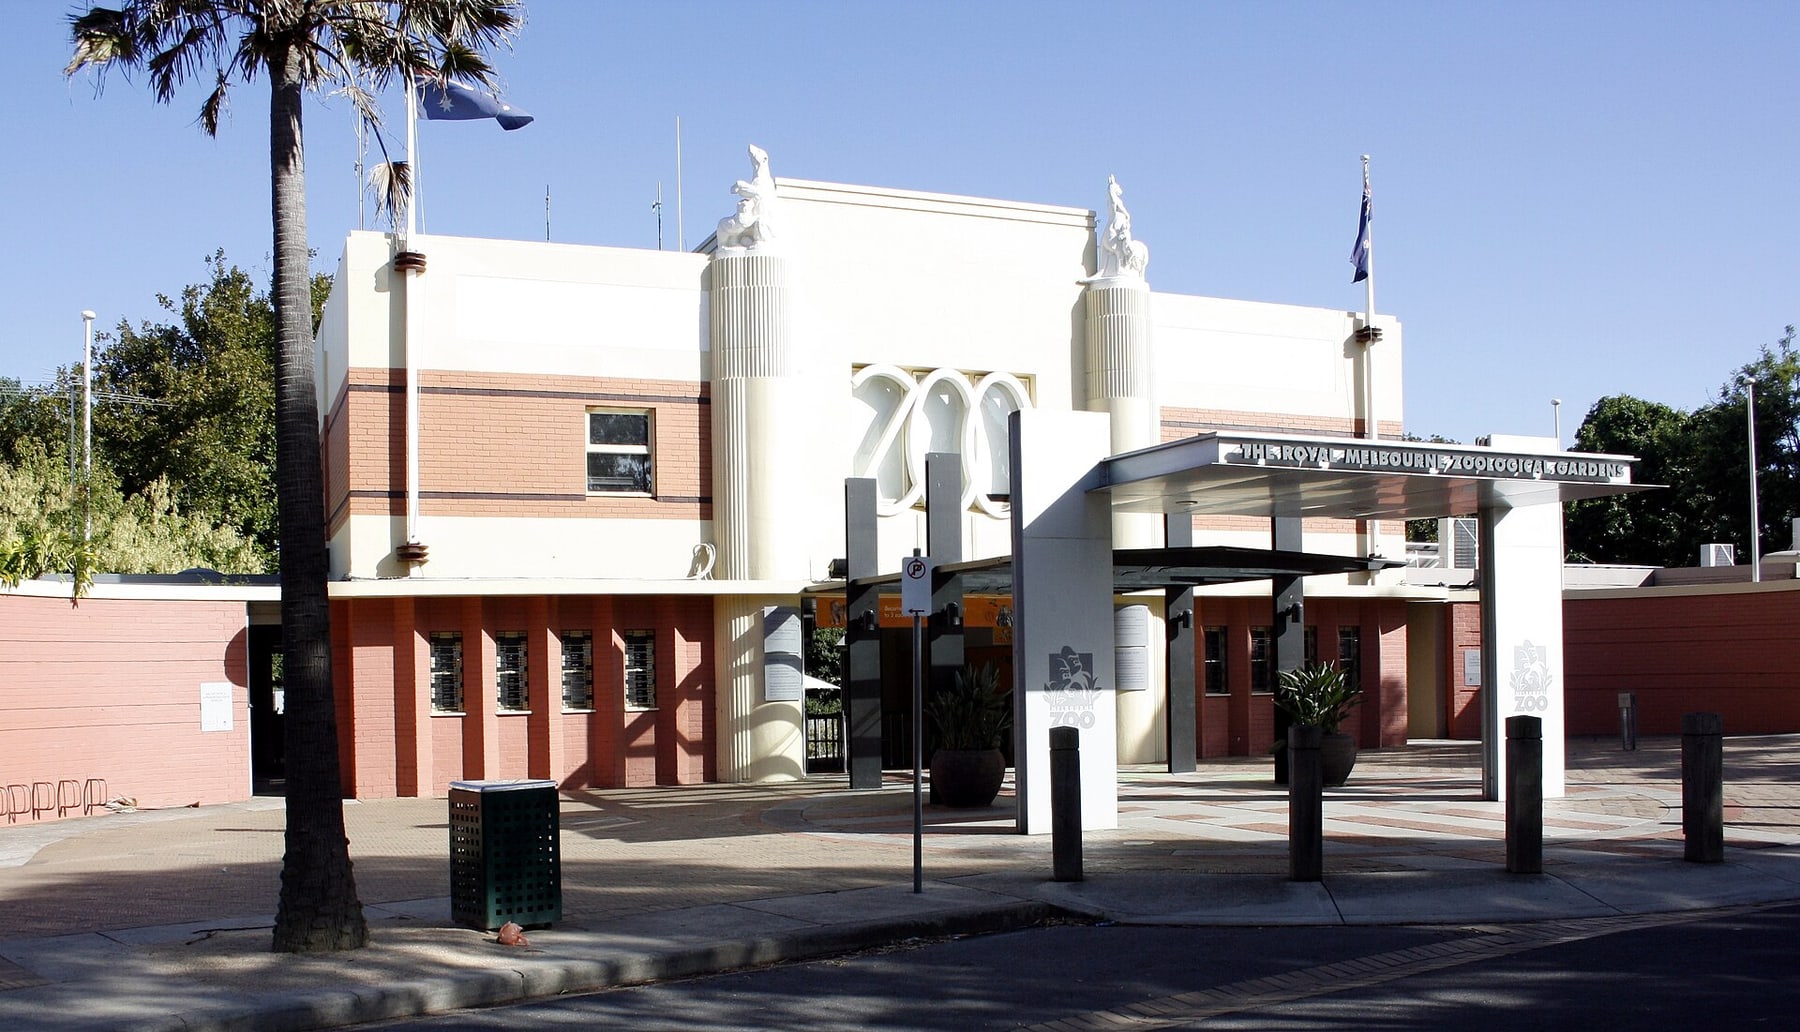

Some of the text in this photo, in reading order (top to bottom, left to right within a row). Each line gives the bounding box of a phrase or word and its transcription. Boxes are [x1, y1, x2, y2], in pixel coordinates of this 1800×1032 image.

[1241, 443, 1625, 478] THE ROYAL MELBOURNE ZOOLOGICAL GARDENS
[1514, 695, 1548, 712] ZOO
[1050, 710, 1096, 730] ZOO
